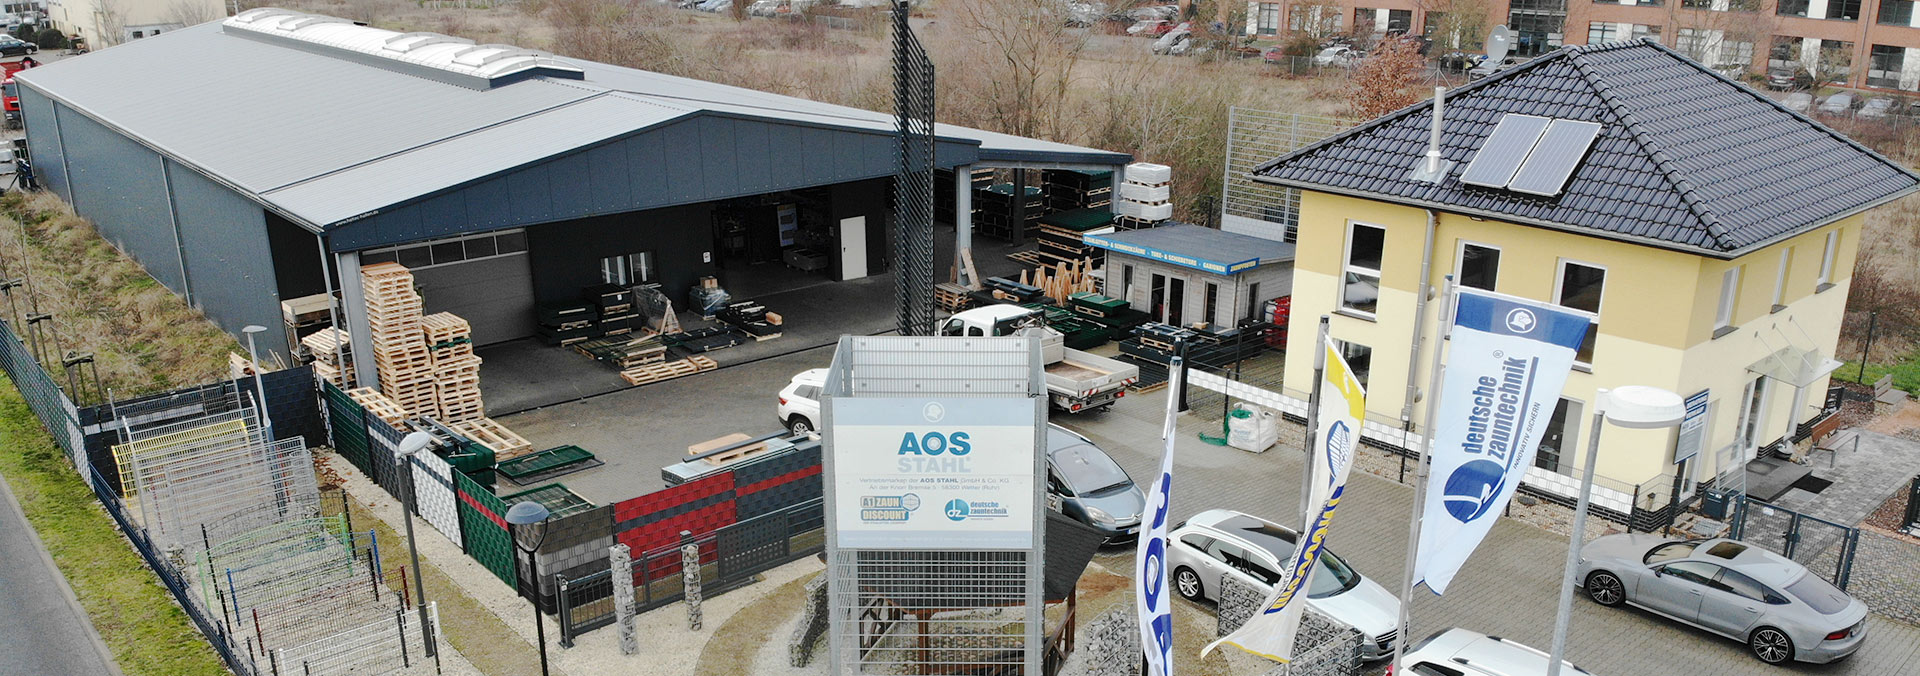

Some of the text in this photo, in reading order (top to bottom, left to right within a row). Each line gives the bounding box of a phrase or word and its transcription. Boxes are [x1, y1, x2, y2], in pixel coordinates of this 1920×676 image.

[1462, 375, 1497, 454] deutsche
[1487, 356, 1527, 461] zauntechnik
[897, 431, 971, 456] AOS
[1513, 402, 1541, 470] INNOVATIV SICHERN
[897, 457, 972, 473] STAHL
[862, 497, 900, 507] A1 ZAUN
[863, 510, 906, 520] DISCOUNT
